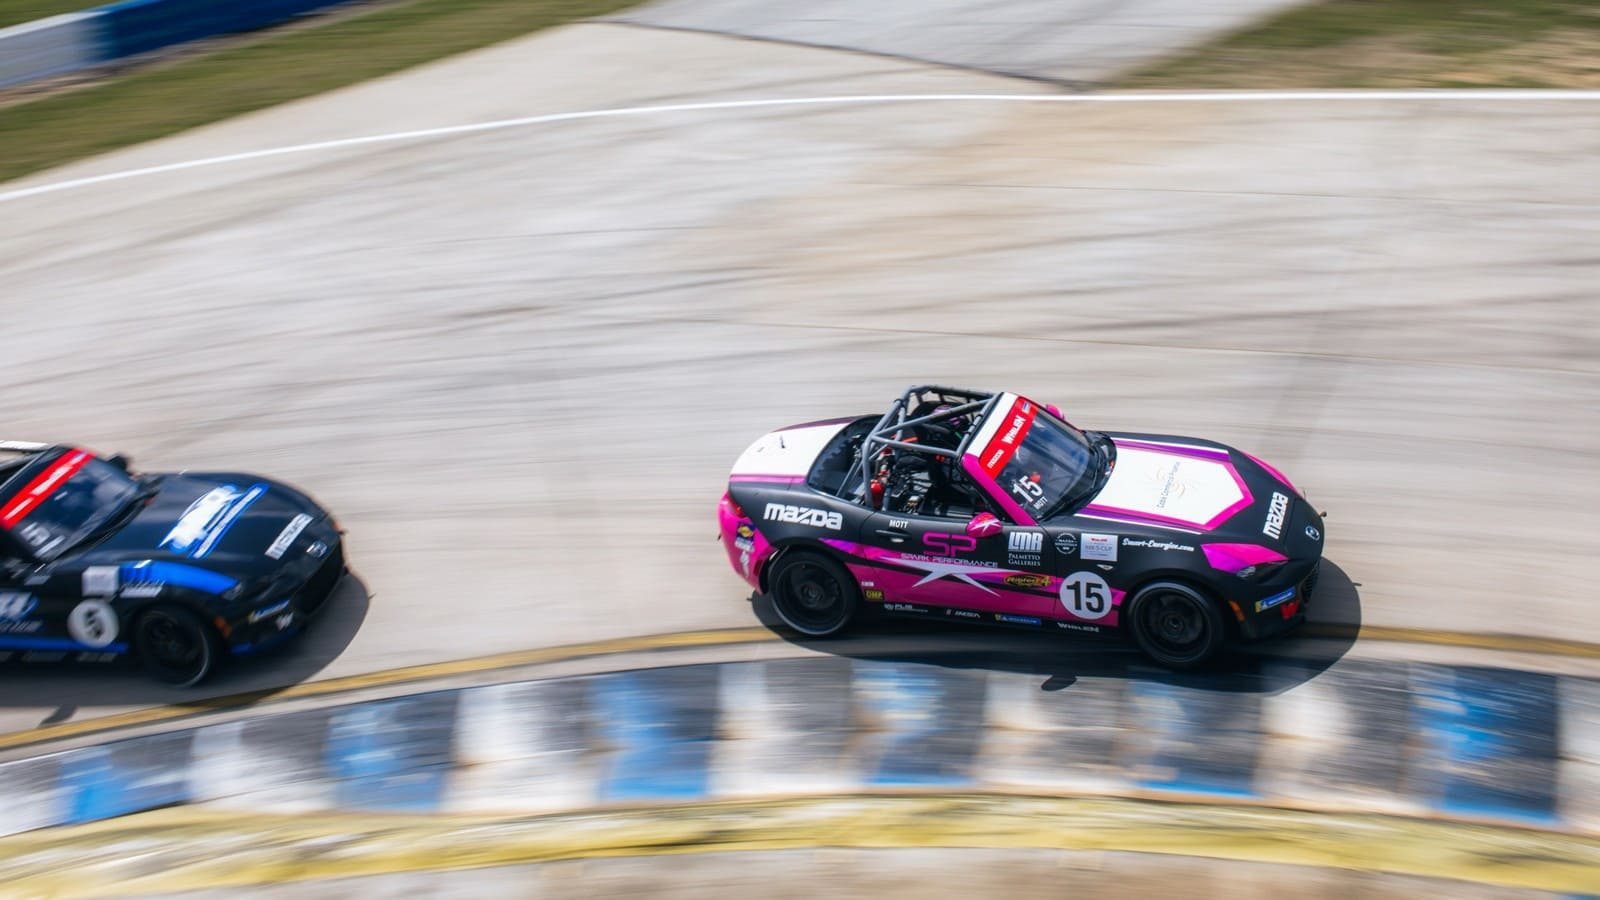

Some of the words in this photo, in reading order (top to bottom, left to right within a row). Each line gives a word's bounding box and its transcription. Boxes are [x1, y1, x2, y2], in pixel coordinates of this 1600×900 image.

[1012, 475, 1043, 502] 15
[889, 519, 909, 529] MOTT
[922, 531, 977, 557] SP
[1008, 531, 1043, 552] LMR
[901, 552, 929, 560] SPARK
[932, 556, 998, 568] PERFORMANCE
[1066, 580, 1105, 613] 15
